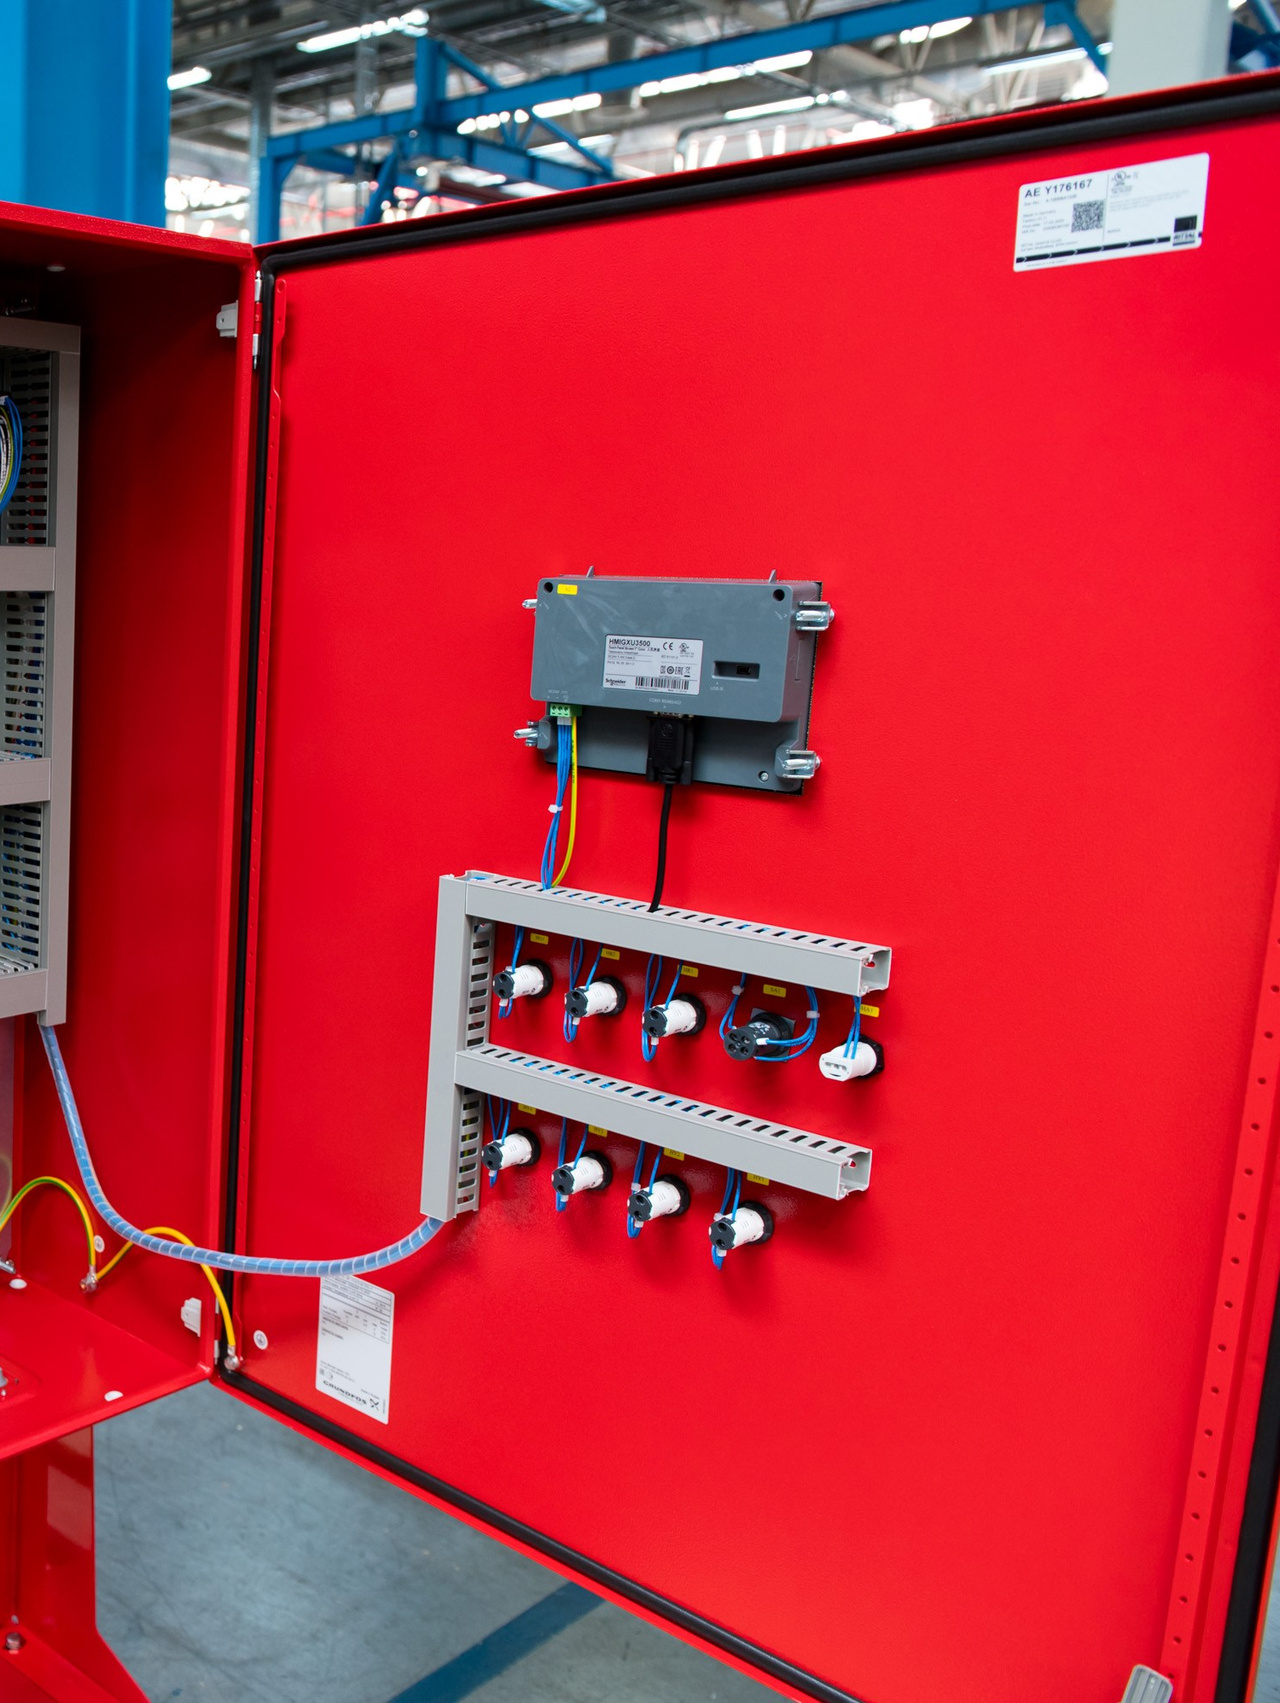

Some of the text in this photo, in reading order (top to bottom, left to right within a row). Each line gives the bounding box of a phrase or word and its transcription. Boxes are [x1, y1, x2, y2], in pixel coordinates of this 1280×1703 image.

[1024, 187, 1041, 198] AE
[1045, 178, 1093, 195] Y176167
[608, 638, 651, 647] HMIGXU3500
[322, 1380, 367, 1406] GRUNDFOS
